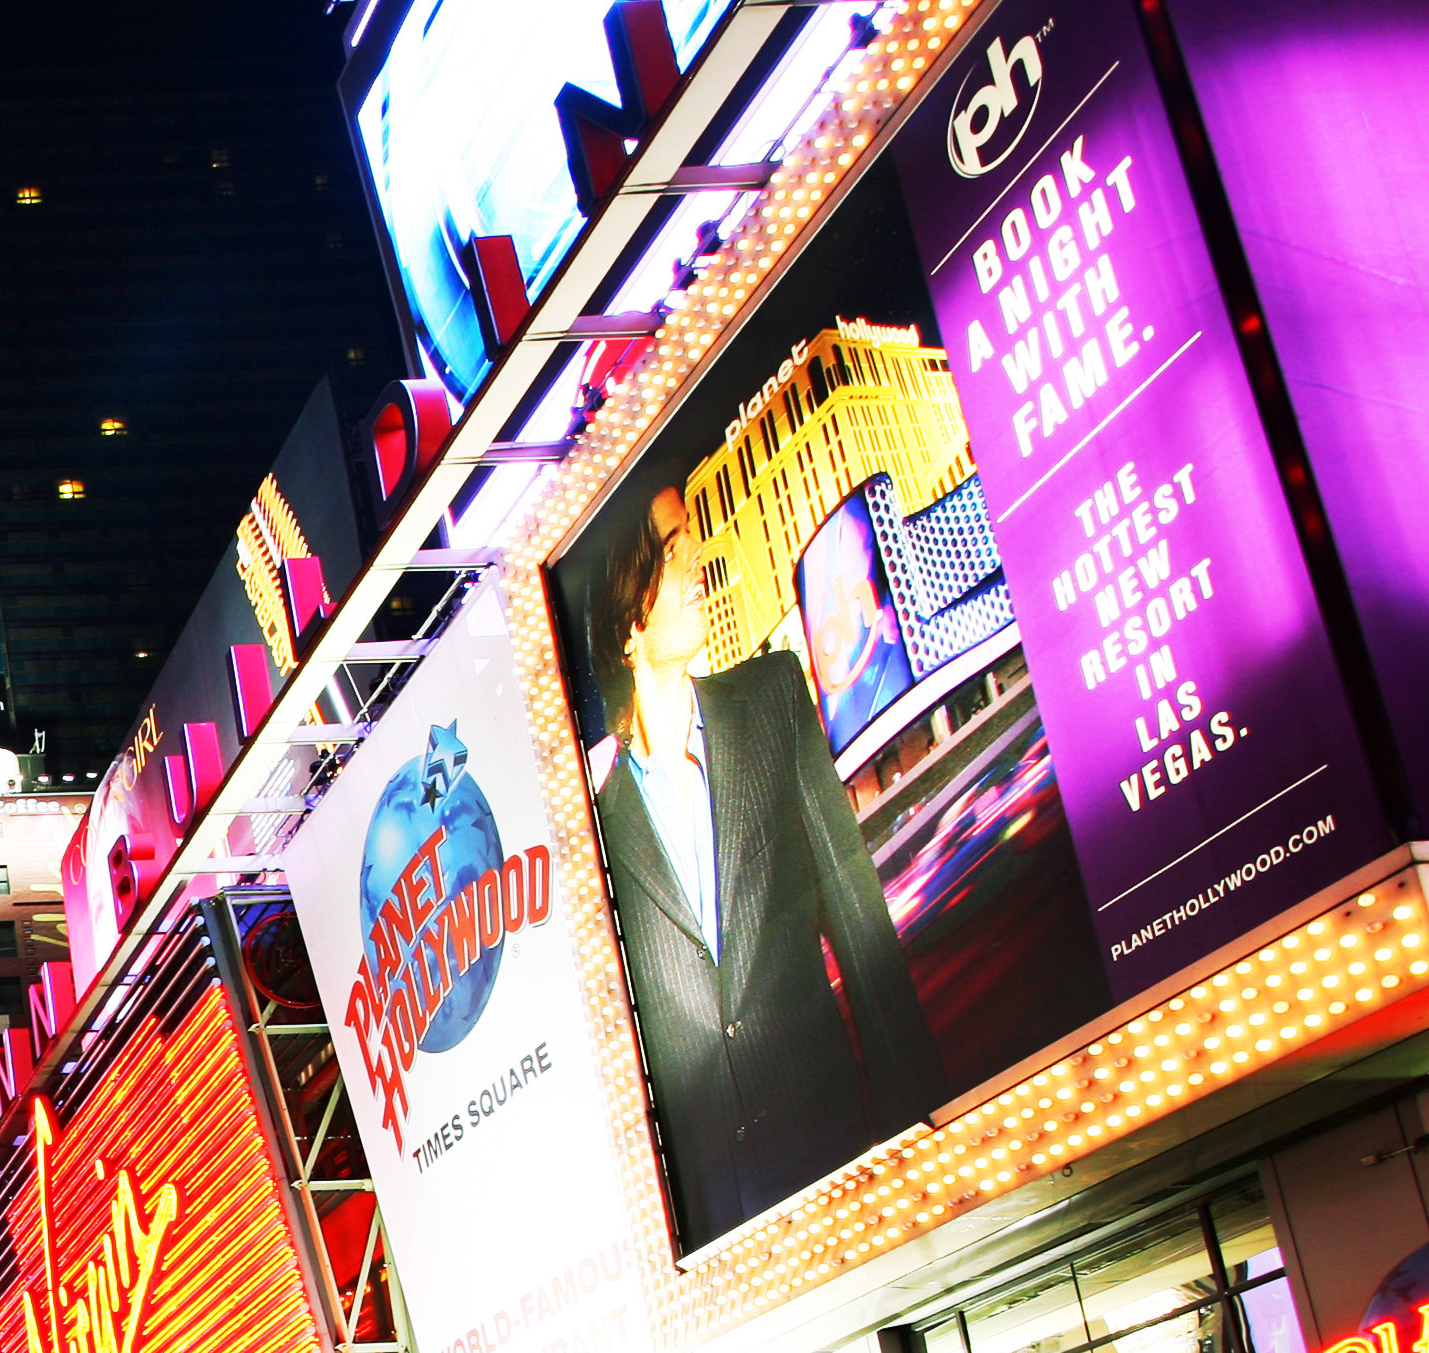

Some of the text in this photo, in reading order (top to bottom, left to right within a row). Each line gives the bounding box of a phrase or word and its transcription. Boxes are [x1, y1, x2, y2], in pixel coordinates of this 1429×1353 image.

[967, 155, 1136, 373] A NIGHT
[972, 134, 1097, 294] BOOK
[724, 314, 920, 451] planet hollywood
[1001, 253, 1120, 395] WITH
[1011, 306, 1155, 459] FAME.
[1051, 463, 1198, 612] HOTTEST
[1074, 461, 1143, 539] THE
[1079, 558, 1215, 691] RESORT
[1093, 540, 1171, 629] NEW
[1134, 644, 1178, 702] IN
[1134, 680, 1203, 754] LAS
[1119, 709, 1249, 813] VEGAS.
[1109, 813, 1337, 963] PLANETHOLLYWOOD.COM
[344, 825, 448, 1100] PLANET
[374, 843, 554, 1161] HOLLYWOOD
[412, 1041, 554, 1174] TIMES SQUARE
